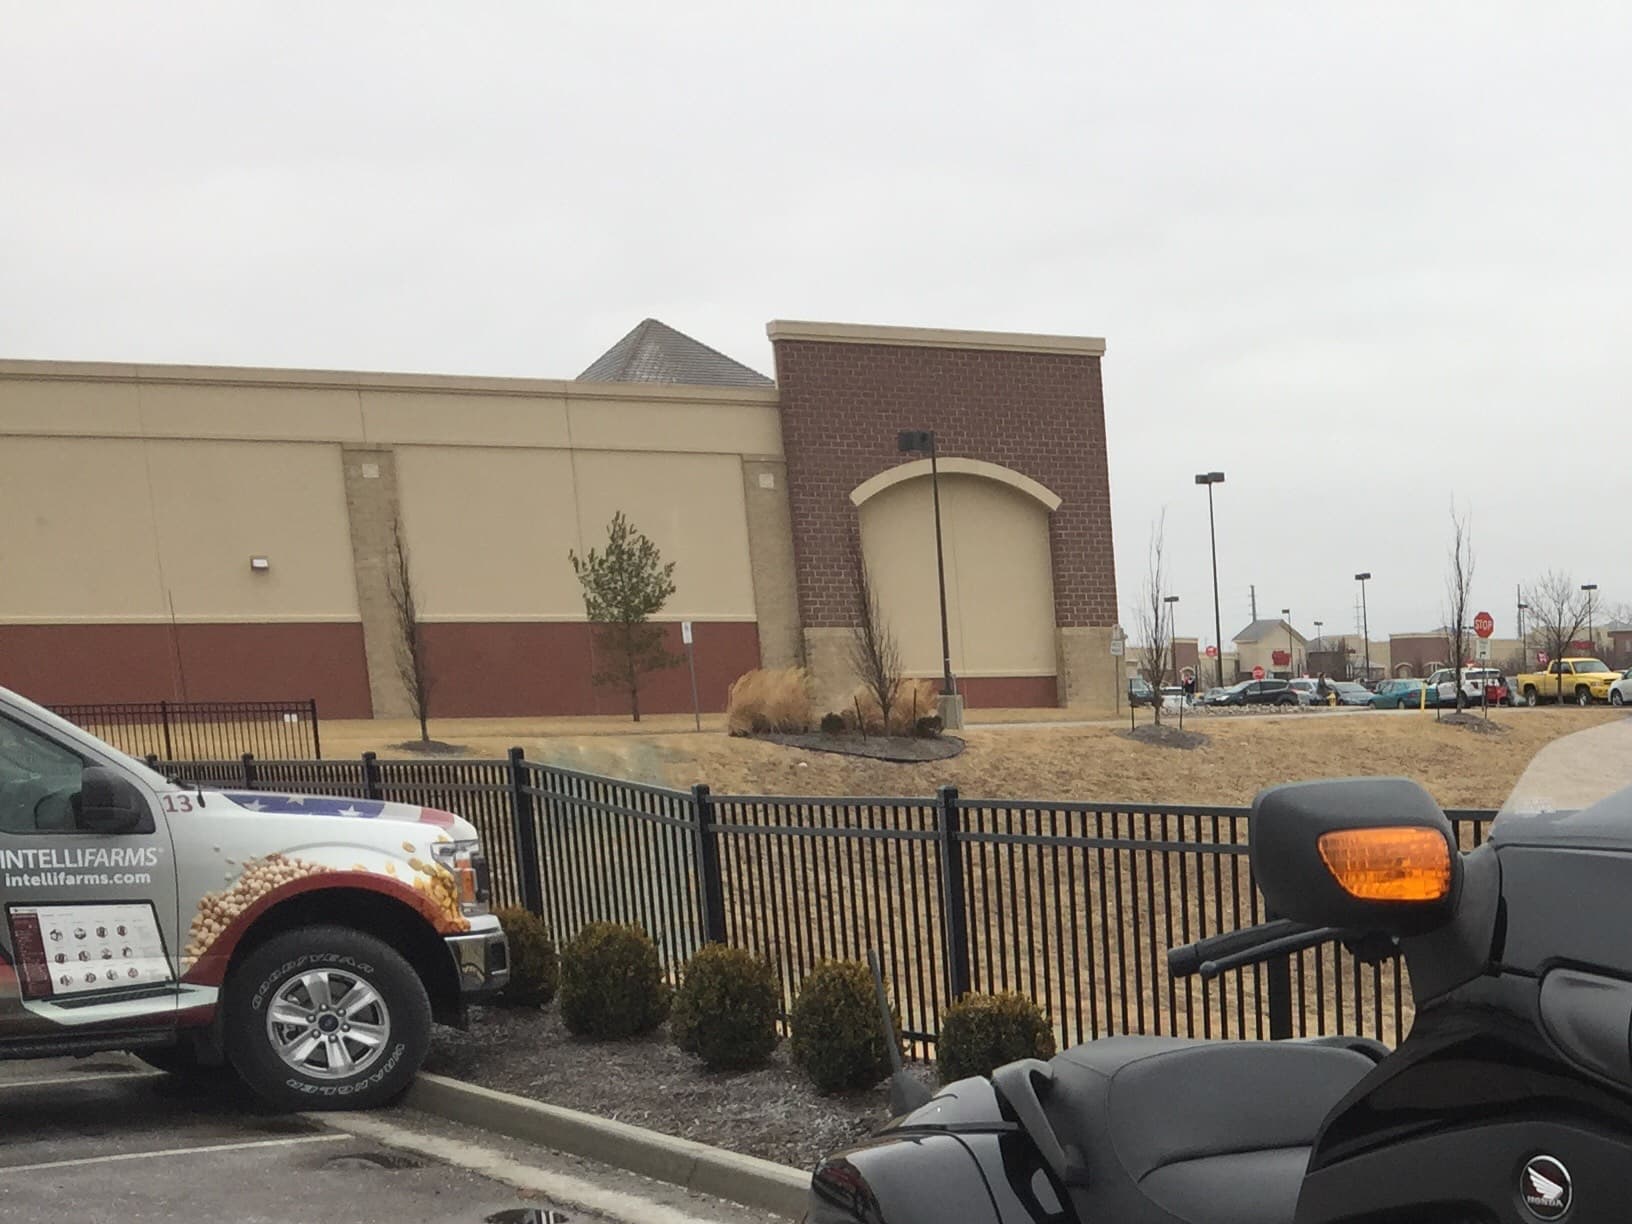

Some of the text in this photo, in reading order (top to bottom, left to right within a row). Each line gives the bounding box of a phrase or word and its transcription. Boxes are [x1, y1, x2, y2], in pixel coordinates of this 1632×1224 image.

[1475, 619, 1493, 631] STOP
[162, 794, 194, 813] 13
[0, 846, 158, 870] INTELLIFARMS
[5, 871, 151, 888] intellifarms.com
[1527, 1195, 1564, 1208] HONDA
